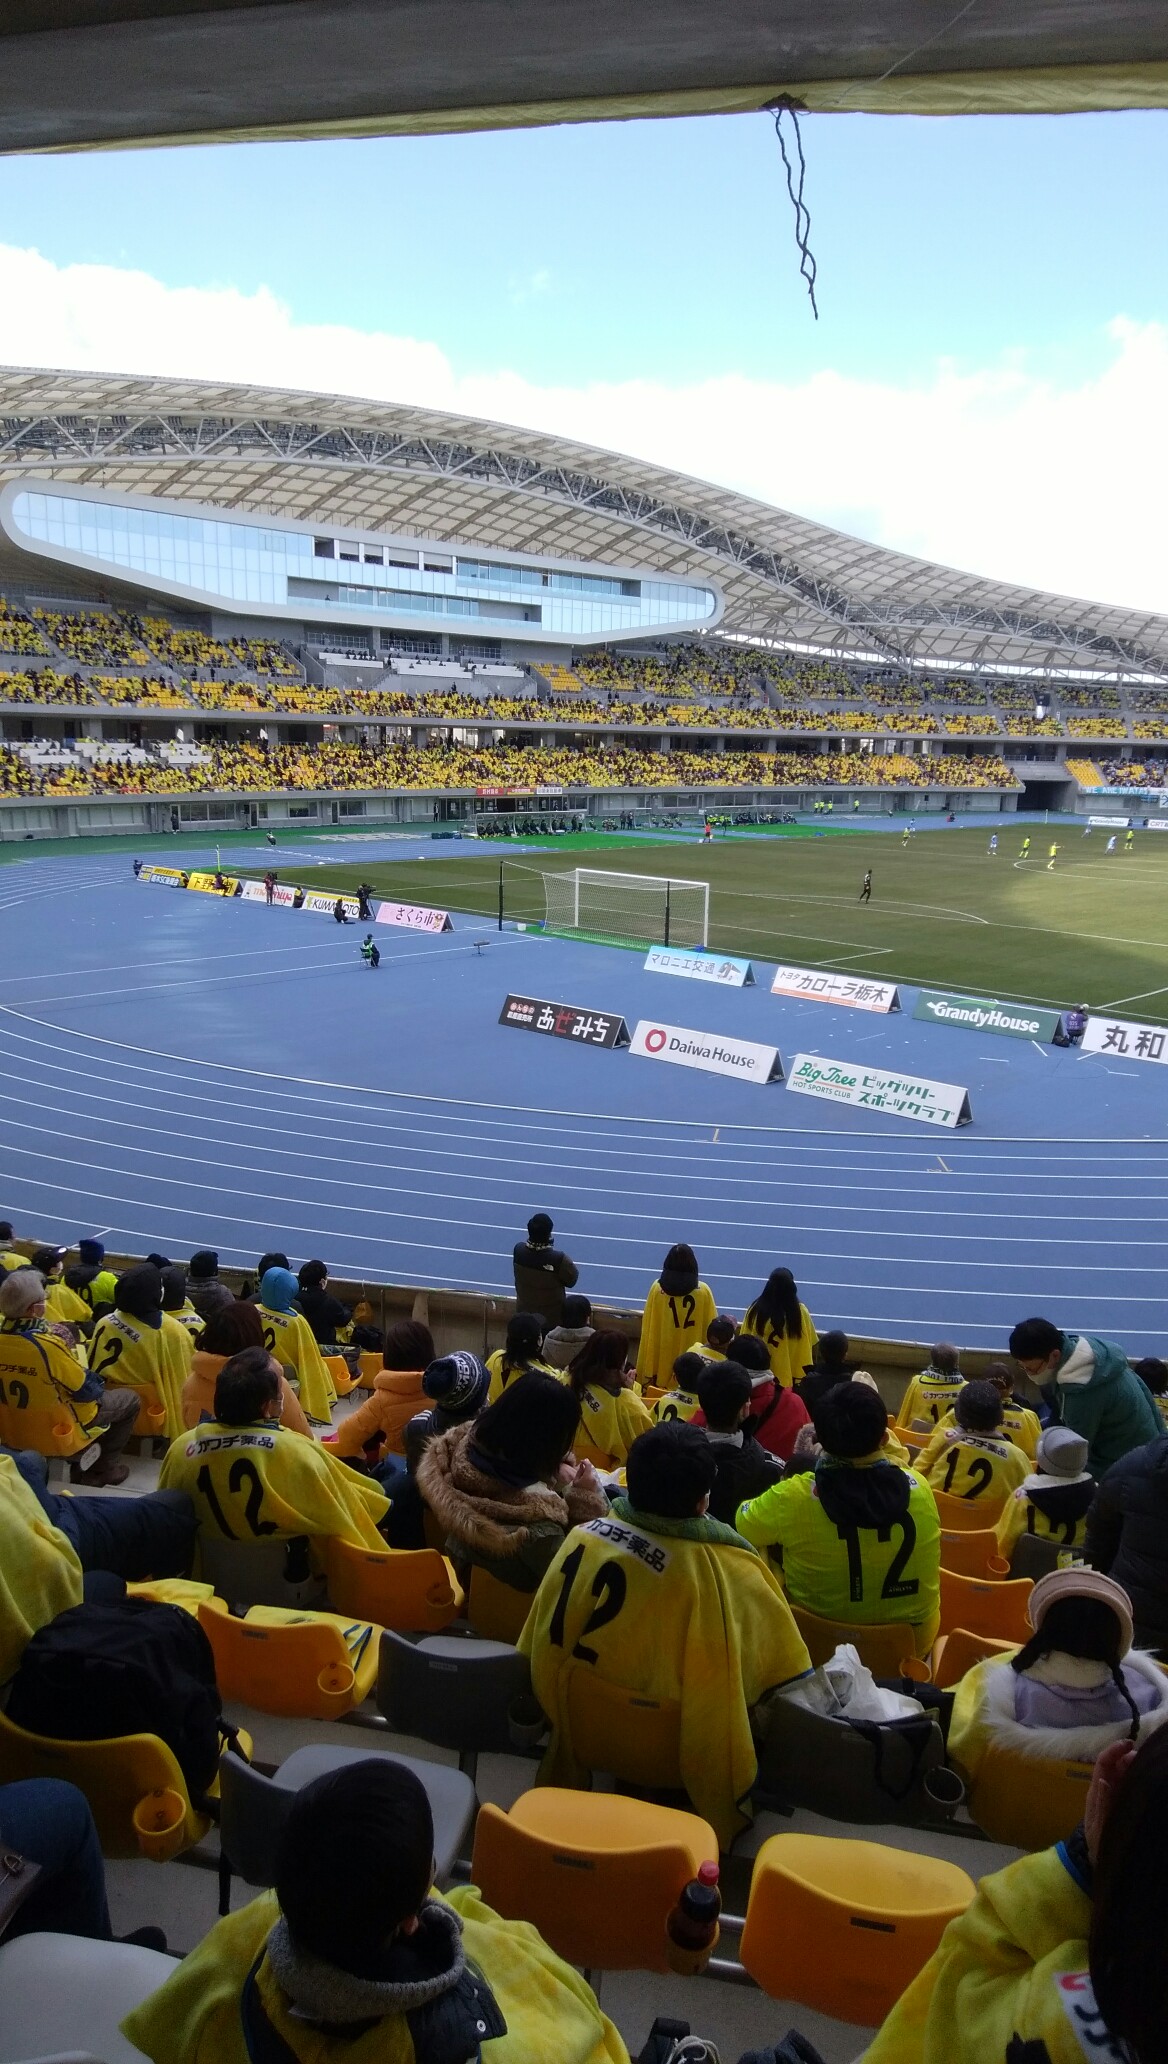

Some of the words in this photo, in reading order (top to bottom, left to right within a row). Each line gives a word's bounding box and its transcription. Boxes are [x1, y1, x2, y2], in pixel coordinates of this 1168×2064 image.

[312, 898, 359, 915] KUMAOTO
[396, 907, 436, 926] さくら市
[651, 953, 716, 975] マロニエ交通
[780, 970, 801, 981] トヨタ
[796, 976, 889, 1003] カローラ栃木
[536, 1006, 610, 1042] あぜみち
[927, 1001, 1040, 1033] GrandyHouse
[669, 1037, 710, 1058] Daiwa
[712, 1047, 755, 1069] House
[1101, 1025, 1167, 1060] 丸和
[792, 1080, 807, 1088] HOT
[808, 1083, 833, 1095] SPORTS
[834, 1089, 852, 1099] CLUB
[795, 1062, 822, 1084] Big
[821, 1067, 858, 1087] Tree
[862, 1075, 936, 1100] ビッグツリー
[857, 1090, 956, 1122] スポーツクラブ
[668, 1294, 696, 1330] 12
[88, 1325, 123, 1374] 12
[929, 1392, 960, 1400] カワチ薬
[197, 1434, 275, 1455] カワチ薬品
[943, 1447, 993, 1500] 12
[197, 1457, 280, 1541] 12
[587, 1519, 667, 1574] カワチ薬品
[836, 1511, 920, 1603] 12
[549, 1543, 627, 1666] 12
